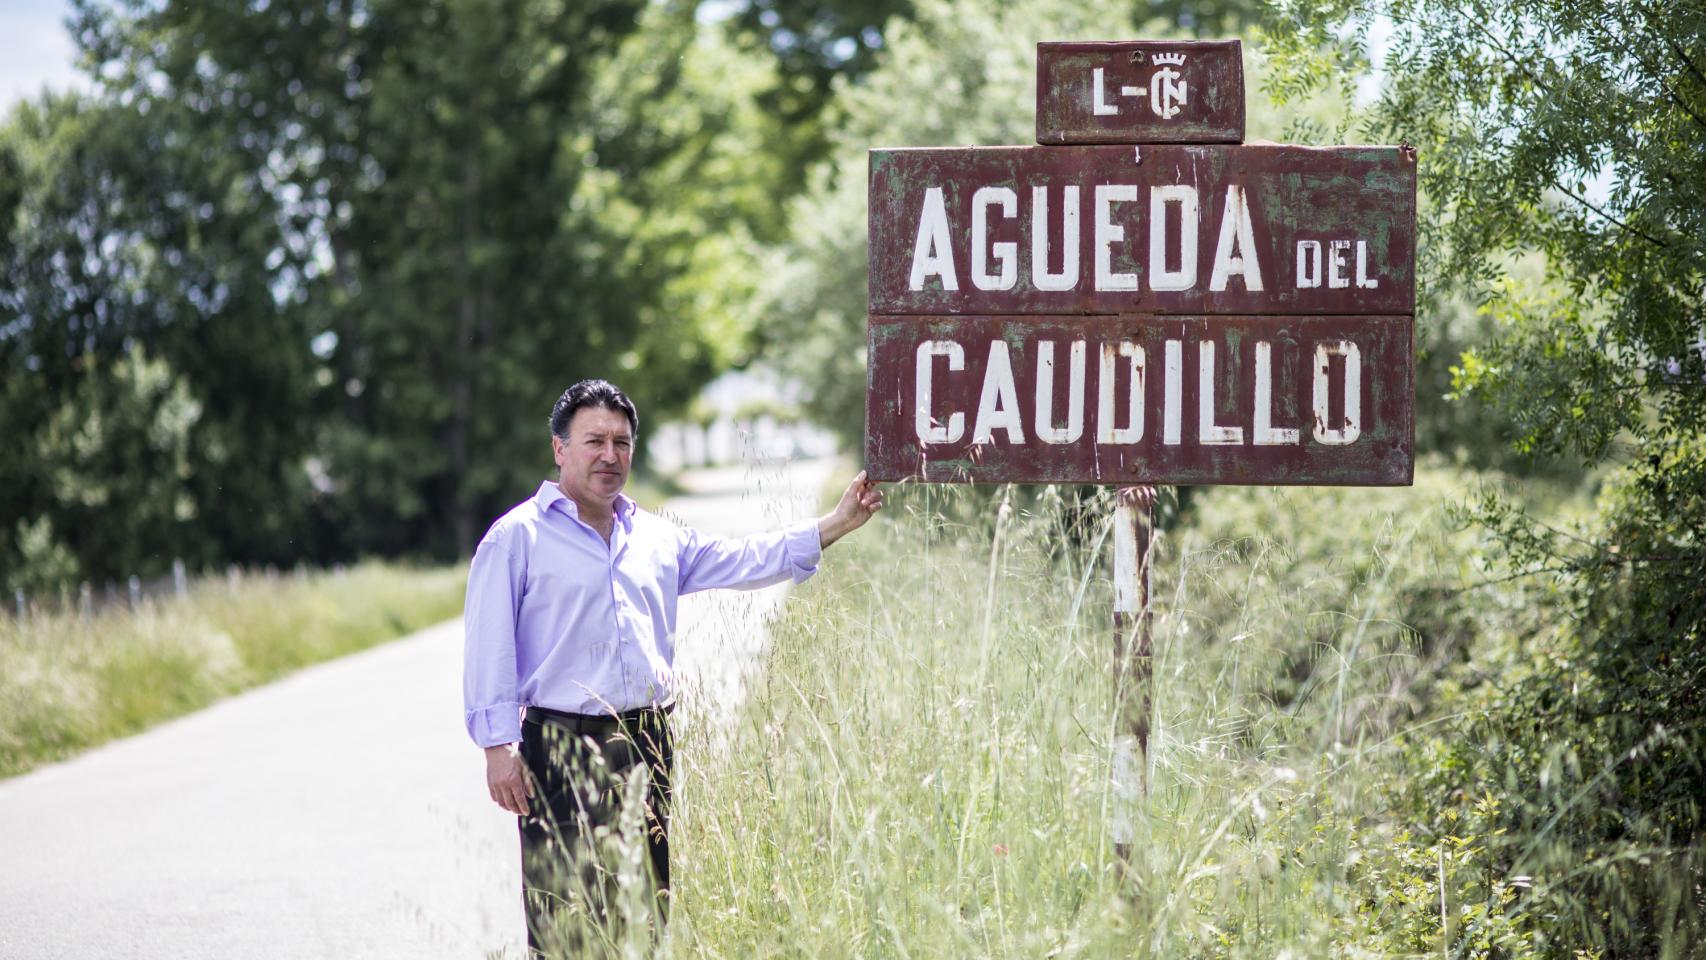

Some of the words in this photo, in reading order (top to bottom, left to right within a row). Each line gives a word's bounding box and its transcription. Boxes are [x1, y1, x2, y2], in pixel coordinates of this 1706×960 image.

[909, 184, 1265, 293] AGUEDA
[1296, 239, 1379, 290] DEL
[914, 339, 1362, 446] CAUDILLO
